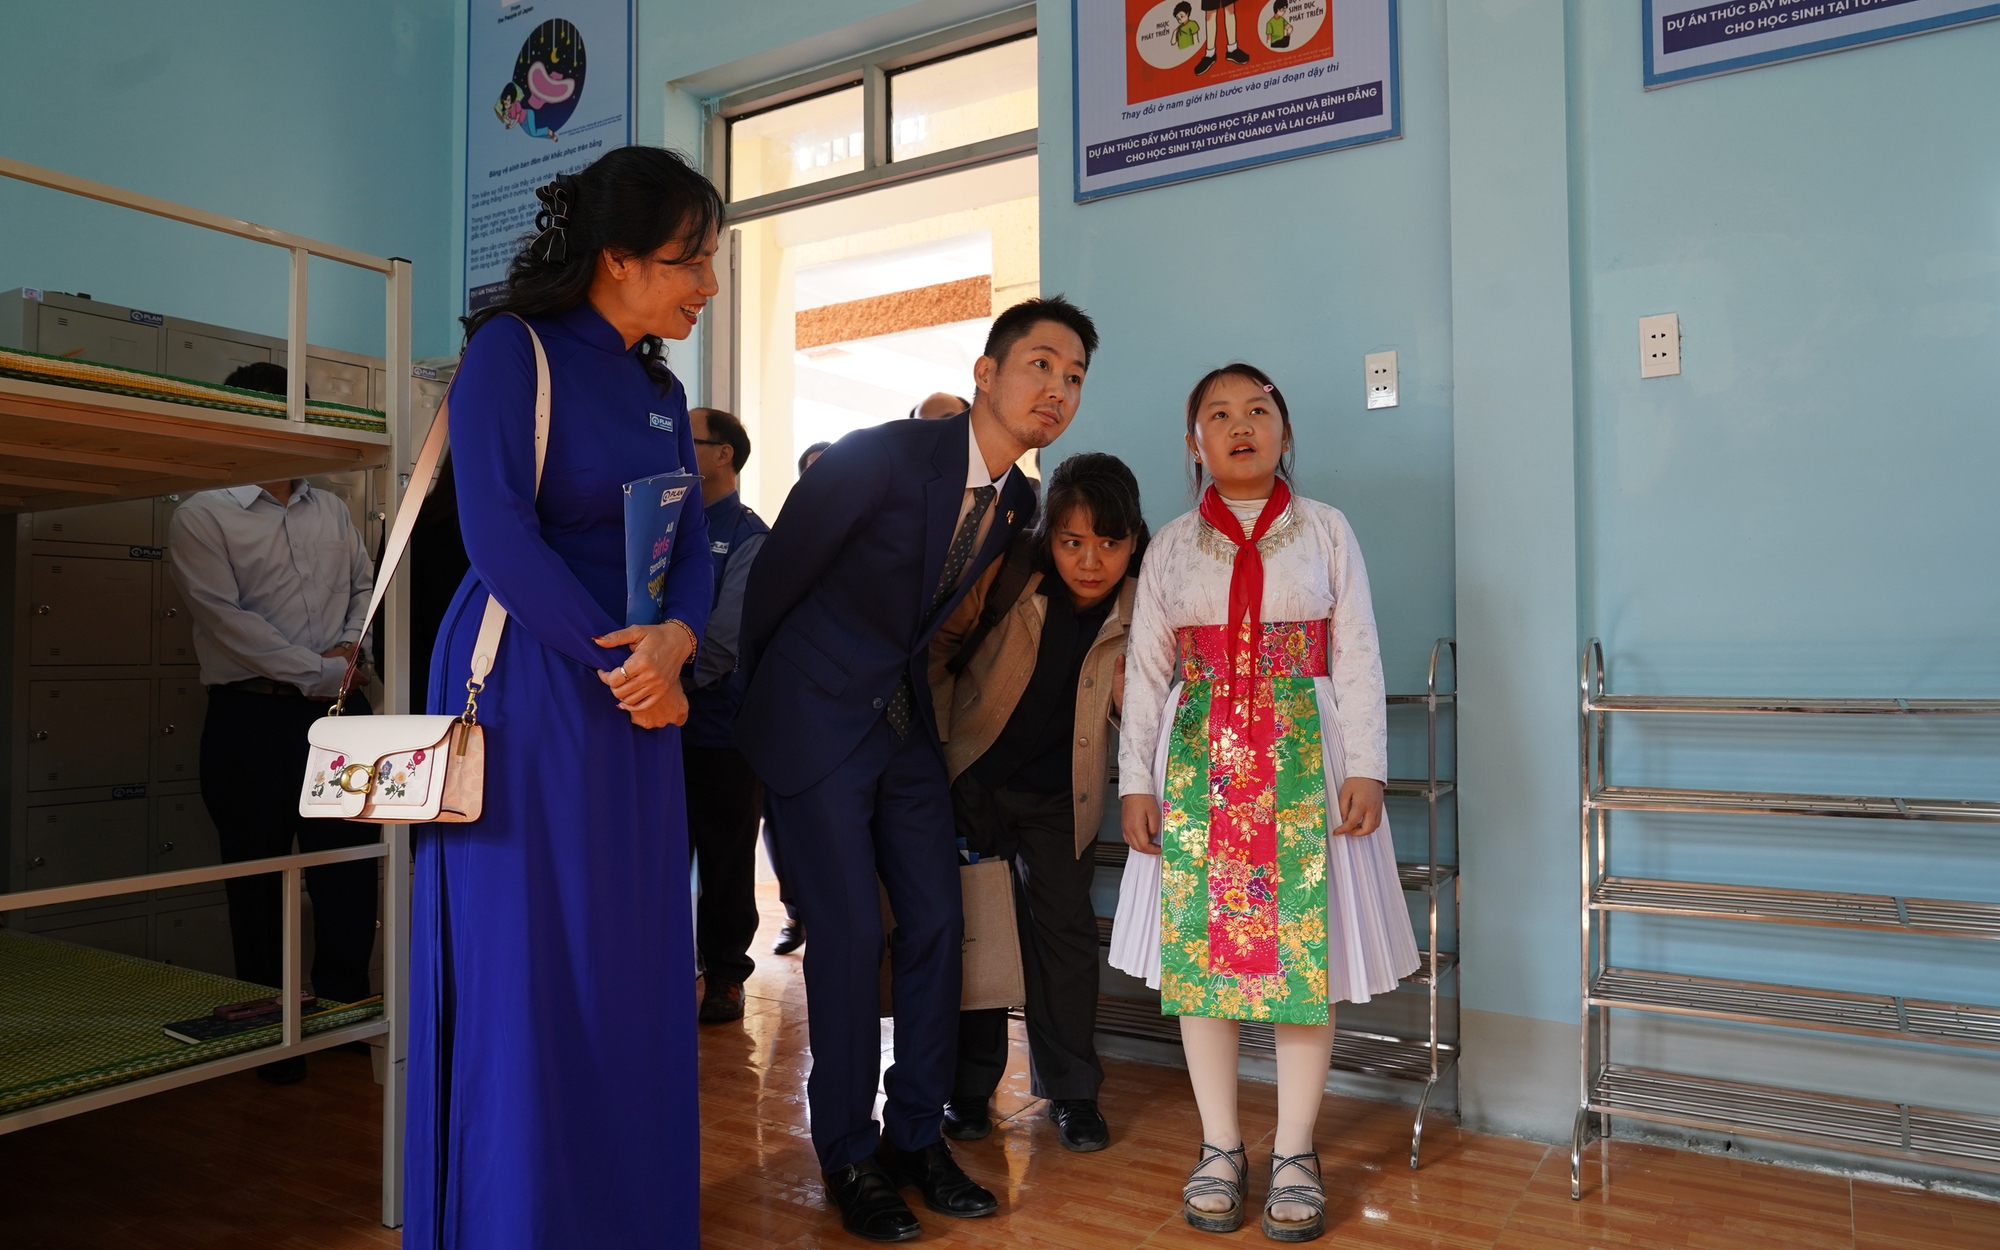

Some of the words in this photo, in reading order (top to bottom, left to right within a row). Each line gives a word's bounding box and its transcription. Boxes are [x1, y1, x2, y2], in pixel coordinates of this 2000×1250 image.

[1289, 4, 1302, 13] SINH
[1289, 13, 1304, 22] PHÁT
[1667, 17, 1686, 31] DỰ
[1688, 13, 1707, 26] ÁN
[1710, 5, 1746, 21] THÚC
[1725, 20, 1754, 34] CHO
[1757, 14, 1788, 28] HỌC
[1792, 7, 1824, 21] SINH
[1827, 0, 1849, 14] TẠI
[1122, 110, 1141, 120] Thay
[1142, 104, 1156, 116] đổi
[1166, 100, 1183, 110] nam
[1186, 94, 1202, 107] giới
[1204, 90, 1218, 101] khi
[1220, 86, 1243, 98] bước
[1245, 81, 1261, 91] vào
[1263, 76, 1280, 89] giai
[1282, 72, 1305, 83] đoạn
[1307, 67, 1325, 78] dậy
[1326, 62, 1339, 73] thì
[1089, 147, 1101, 159] DỰ
[1102, 145, 1115, 155] ÁN
[1116, 139, 1140, 152] THÚC
[1141, 133, 1158, 146] ĐẨY
[1160, 130, 1178, 142] MÔI
[1179, 122, 1217, 137] TRƯỜNG
[1219, 118, 1240, 130] HỌC
[1242, 113, 1259, 125] TẬP
[1261, 110, 1275, 120] AN
[1277, 103, 1304, 117] TOÀN
[1306, 98, 1319, 110] VÀ
[1321, 94, 1345, 107] BÌNH
[1347, 87, 1377, 102] ĐẲNG
[1126, 153, 1145, 163] CHO
[1147, 148, 1166, 159] HỌC
[1168, 142, 1189, 154] SINH
[1191, 139, 1204, 151] TẠI
[1206, 132, 1236, 146] TUYÊN
[1238, 126, 1272, 140] QUANG
[1274, 120, 1287, 131] VÀ
[1290, 118, 1304, 128] LAI
[1305, 111, 1335, 125] CHÂU
[509, 163, 519, 172] sinh
[564, 148, 576, 157] phục
[144, 314, 162, 322] PLAN
[422, 369, 436, 377] PLAN
[670, 488, 685, 498] PLAN
[666, 522, 674, 534] All
[143, 548, 162, 557] PLAN
[652, 536, 670, 559] Girls
[650, 557, 667, 575] Standing
[126, 787, 144, 796] PLAN
